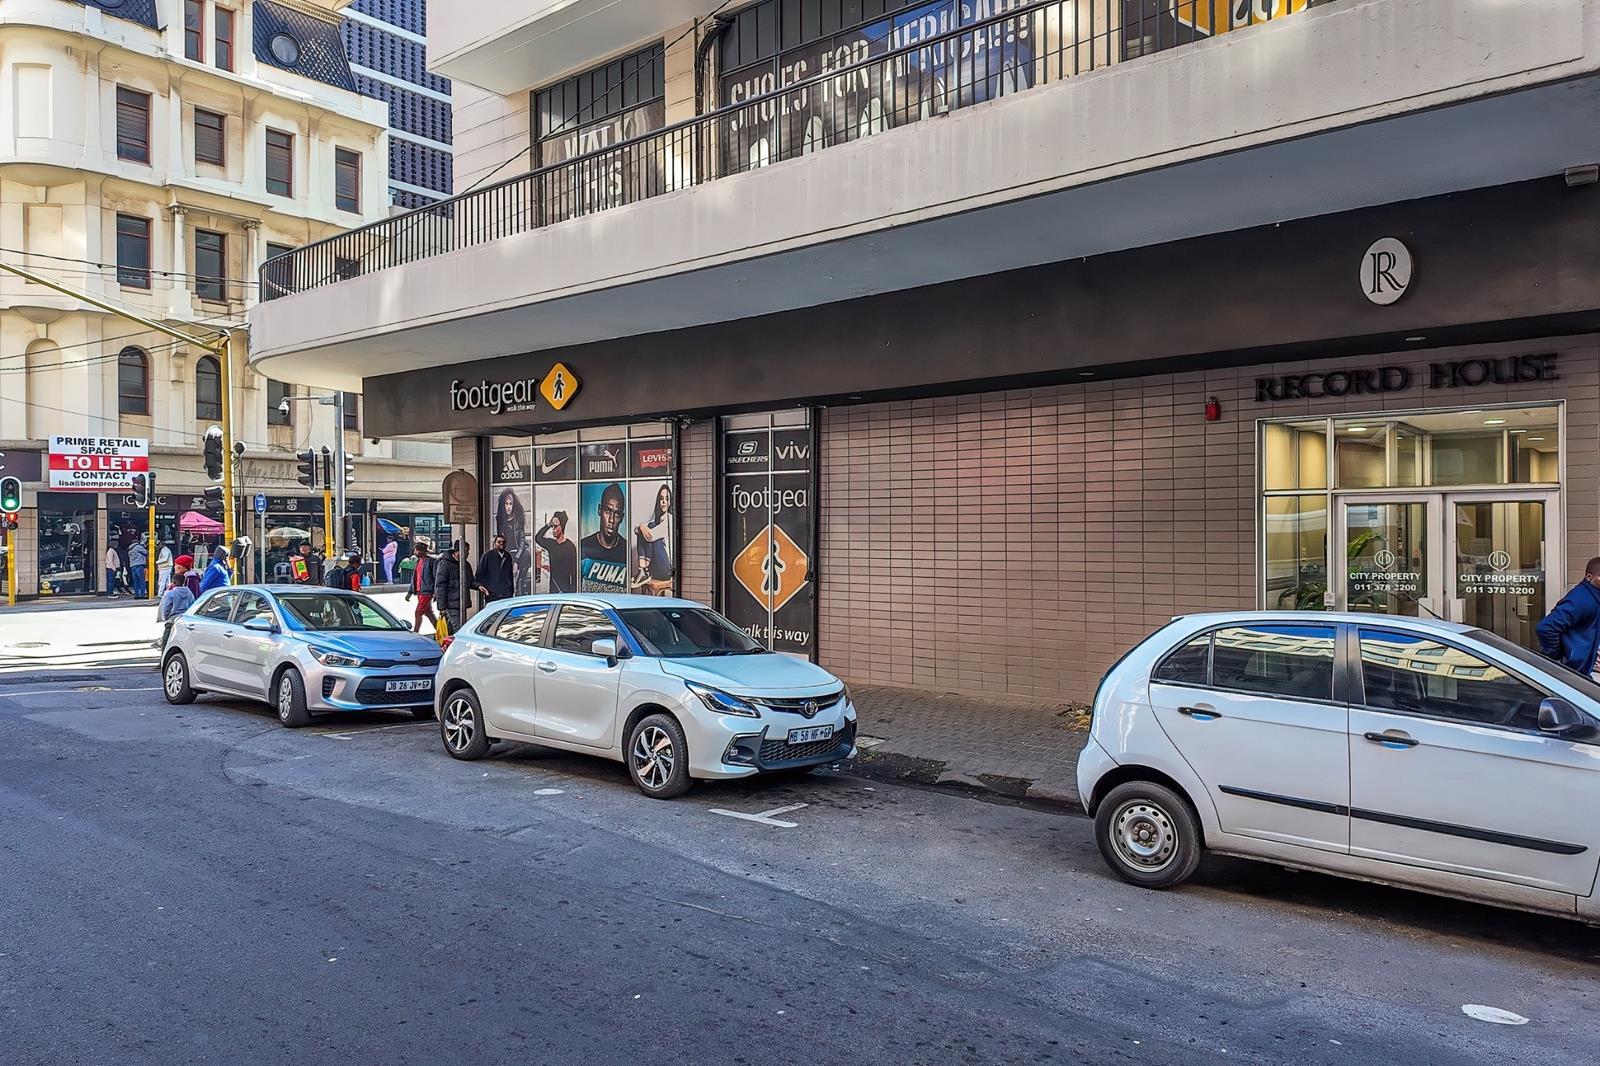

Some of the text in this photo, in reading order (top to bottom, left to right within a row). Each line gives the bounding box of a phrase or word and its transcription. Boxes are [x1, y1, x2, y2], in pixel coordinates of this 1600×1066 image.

[730, 59, 808, 132] SHOES
[821, 39, 870, 102] FOR
[1369, 251, 1407, 294] R
[1253, 352, 1560, 402] RECORD HOUSE
[449, 378, 536, 415] footgear
[56, 437, 141, 448] PRIME RETAIL
[80, 446, 119, 455] SPACE
[775, 441, 809, 460] viv
[64, 456, 135, 470] TO LET
[727, 455, 768, 464] SKECHERS
[589, 460, 613, 473] PUMA
[73, 471, 128, 480] CONTACT
[500, 469, 524, 480] adidas
[122, 495, 167, 505] ICIC
[731, 484, 810, 514] footgea
[588, 562, 627, 585] PUMA
[1349, 572, 1421, 580] CITY PROPERTY
[1460, 574, 1539, 583] CITY PROPERTY
[1354, 583, 1371, 591] 011
[1508, 587, 1535, 595] 3200
[742, 624, 810, 646] alk tis way
